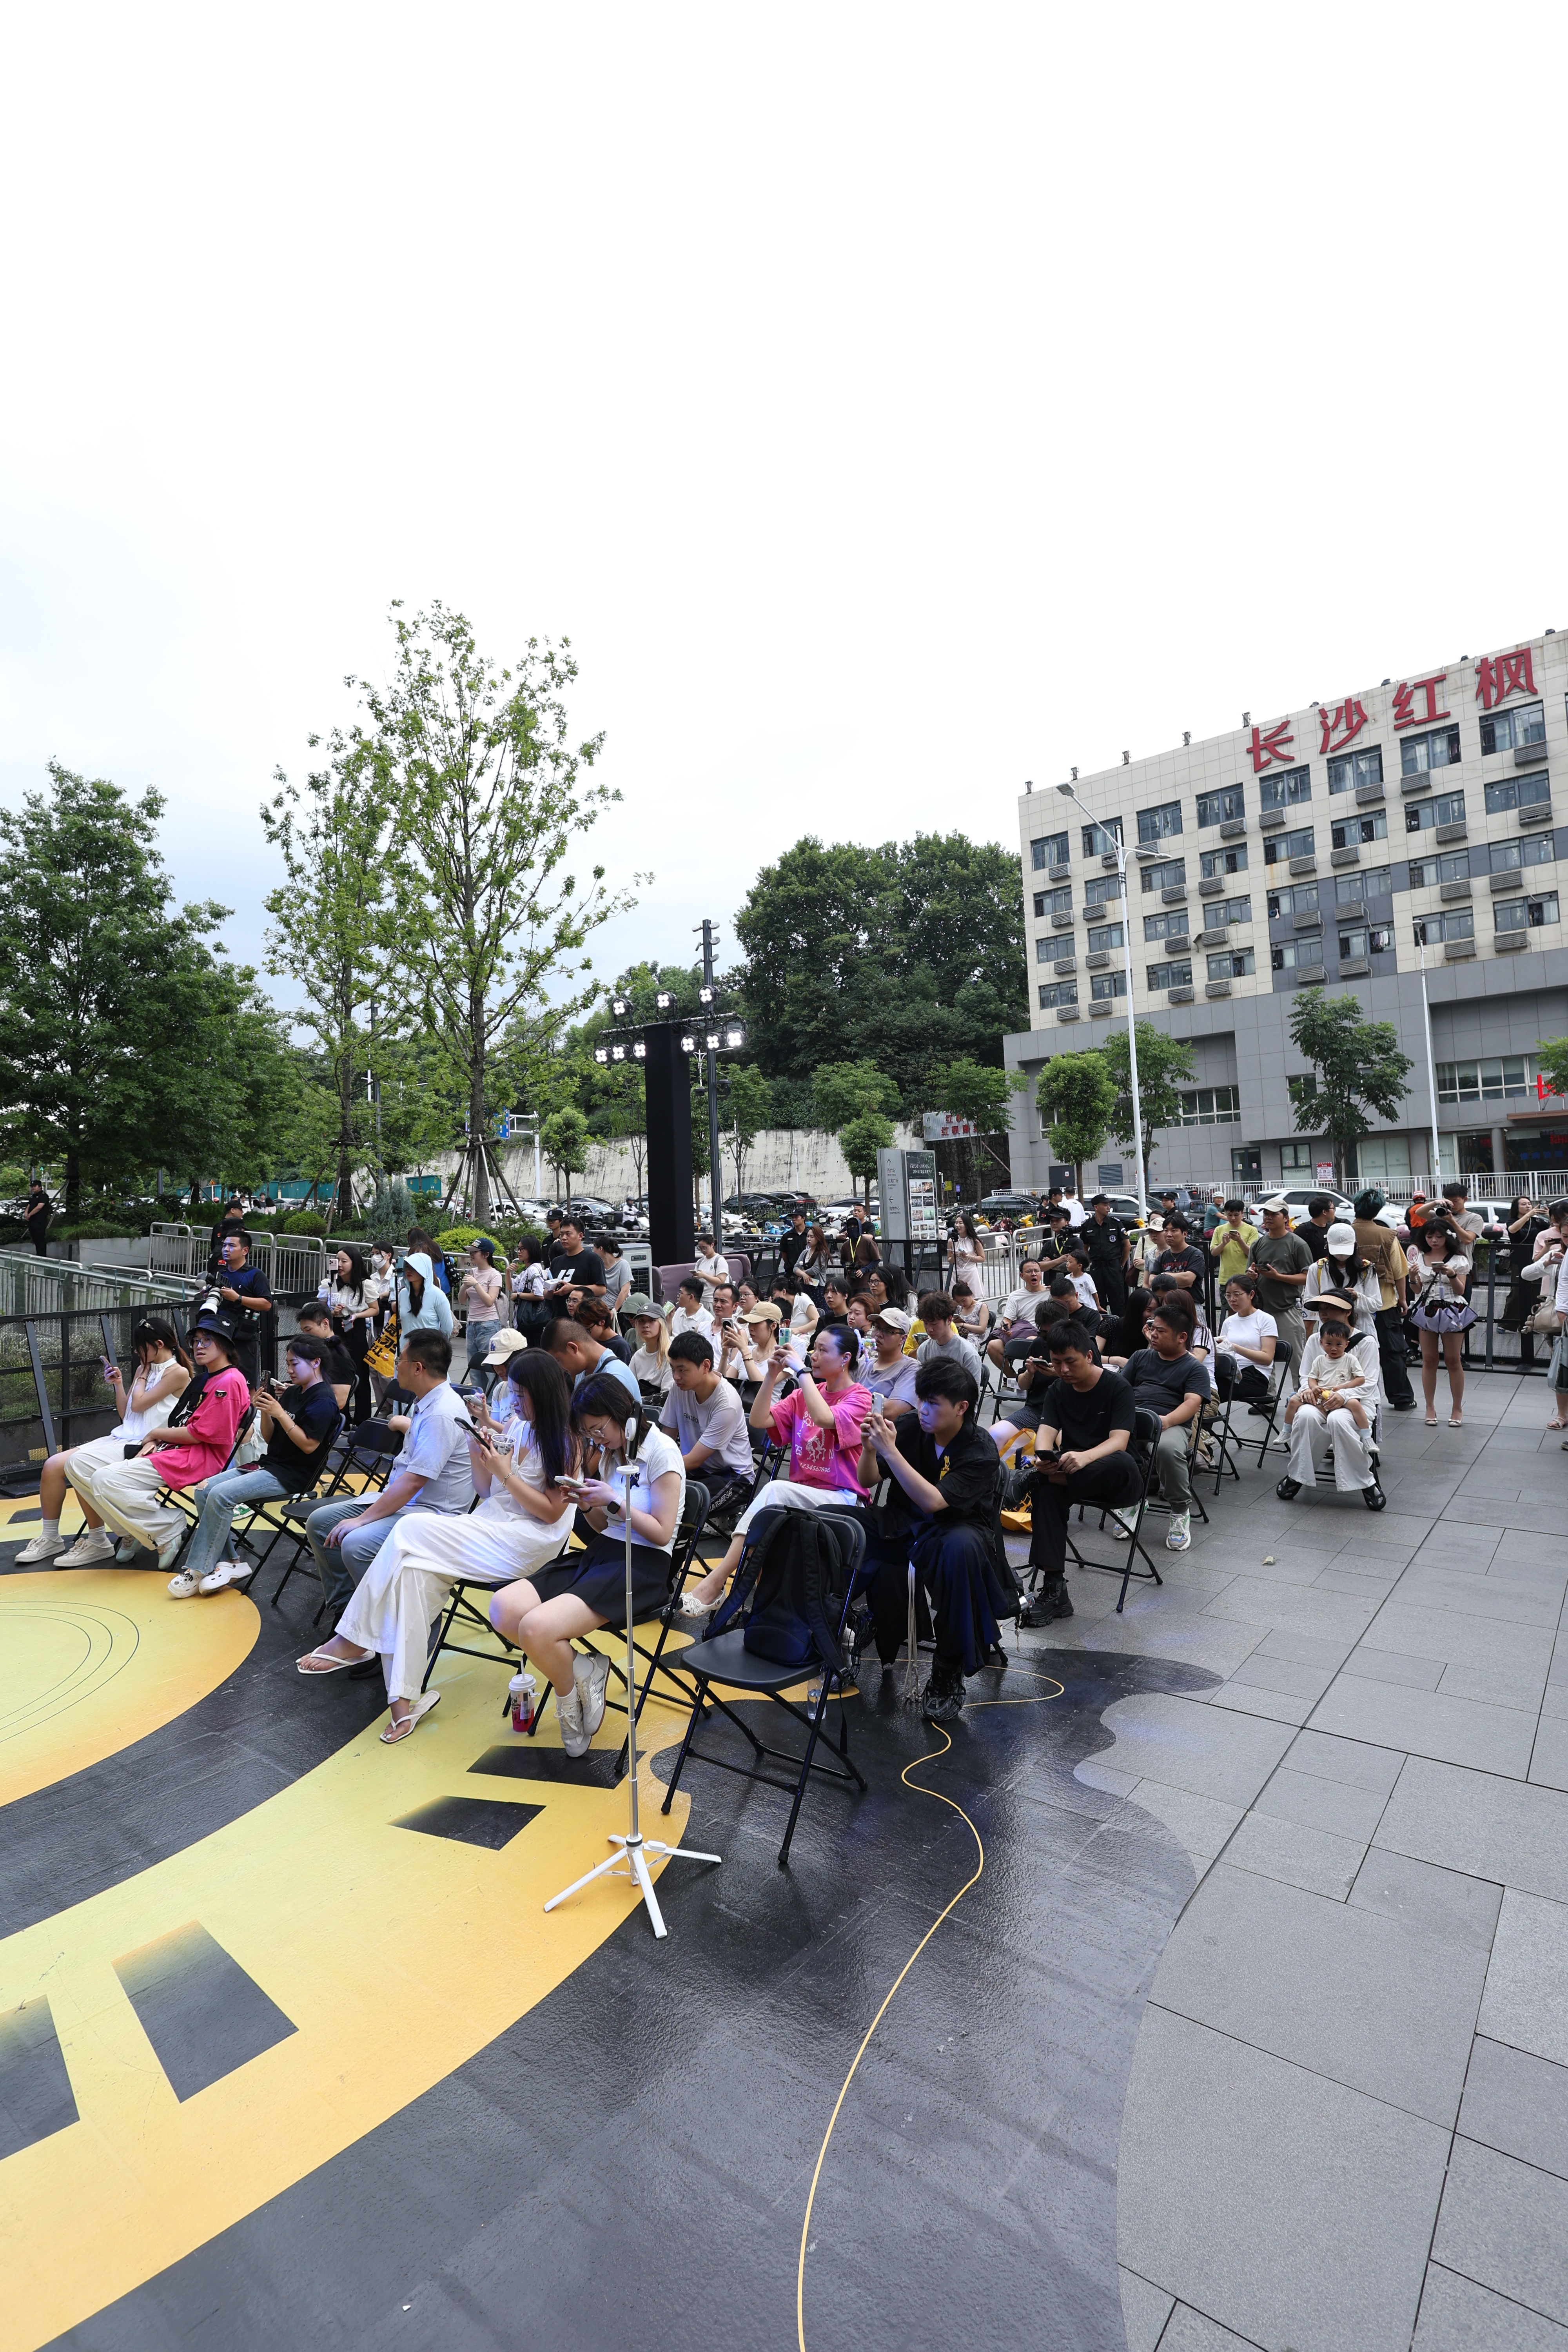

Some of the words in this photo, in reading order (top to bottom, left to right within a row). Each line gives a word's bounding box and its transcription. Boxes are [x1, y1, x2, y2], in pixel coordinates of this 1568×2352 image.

[1247, 647, 1538, 772] 长沙红枫
[800, 1463, 831, 1473] 1234567890
